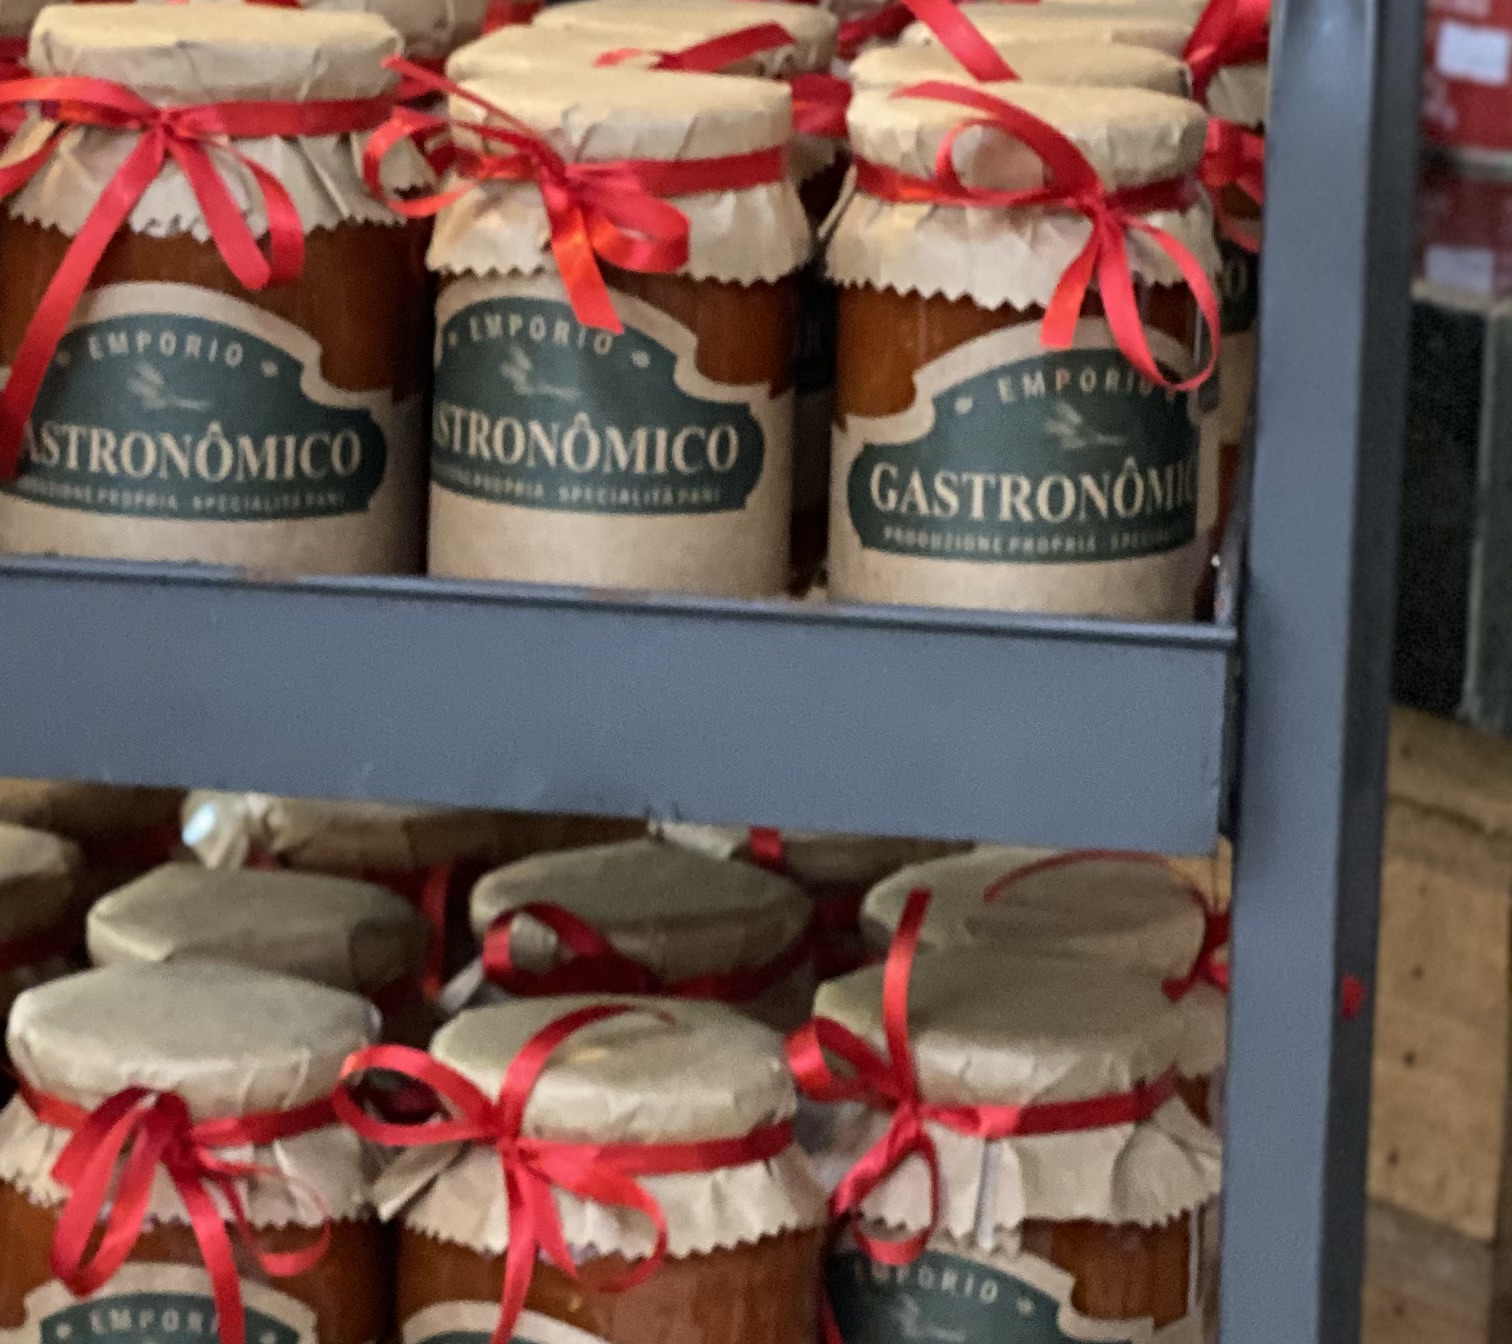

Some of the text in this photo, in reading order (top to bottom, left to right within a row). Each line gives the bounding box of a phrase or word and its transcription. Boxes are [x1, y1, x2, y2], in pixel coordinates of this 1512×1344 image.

[89, 330, 244, 368] EMPORIO
[469, 312, 614, 356] EMPORIO
[26, 418, 362, 483] ASTRONÔMICO
[434, 400, 740, 476] STRONÔMICO
[869, 456, 1197, 524] GASTRONÔMIC
[90, 1307, 222, 1335] EMPORI
